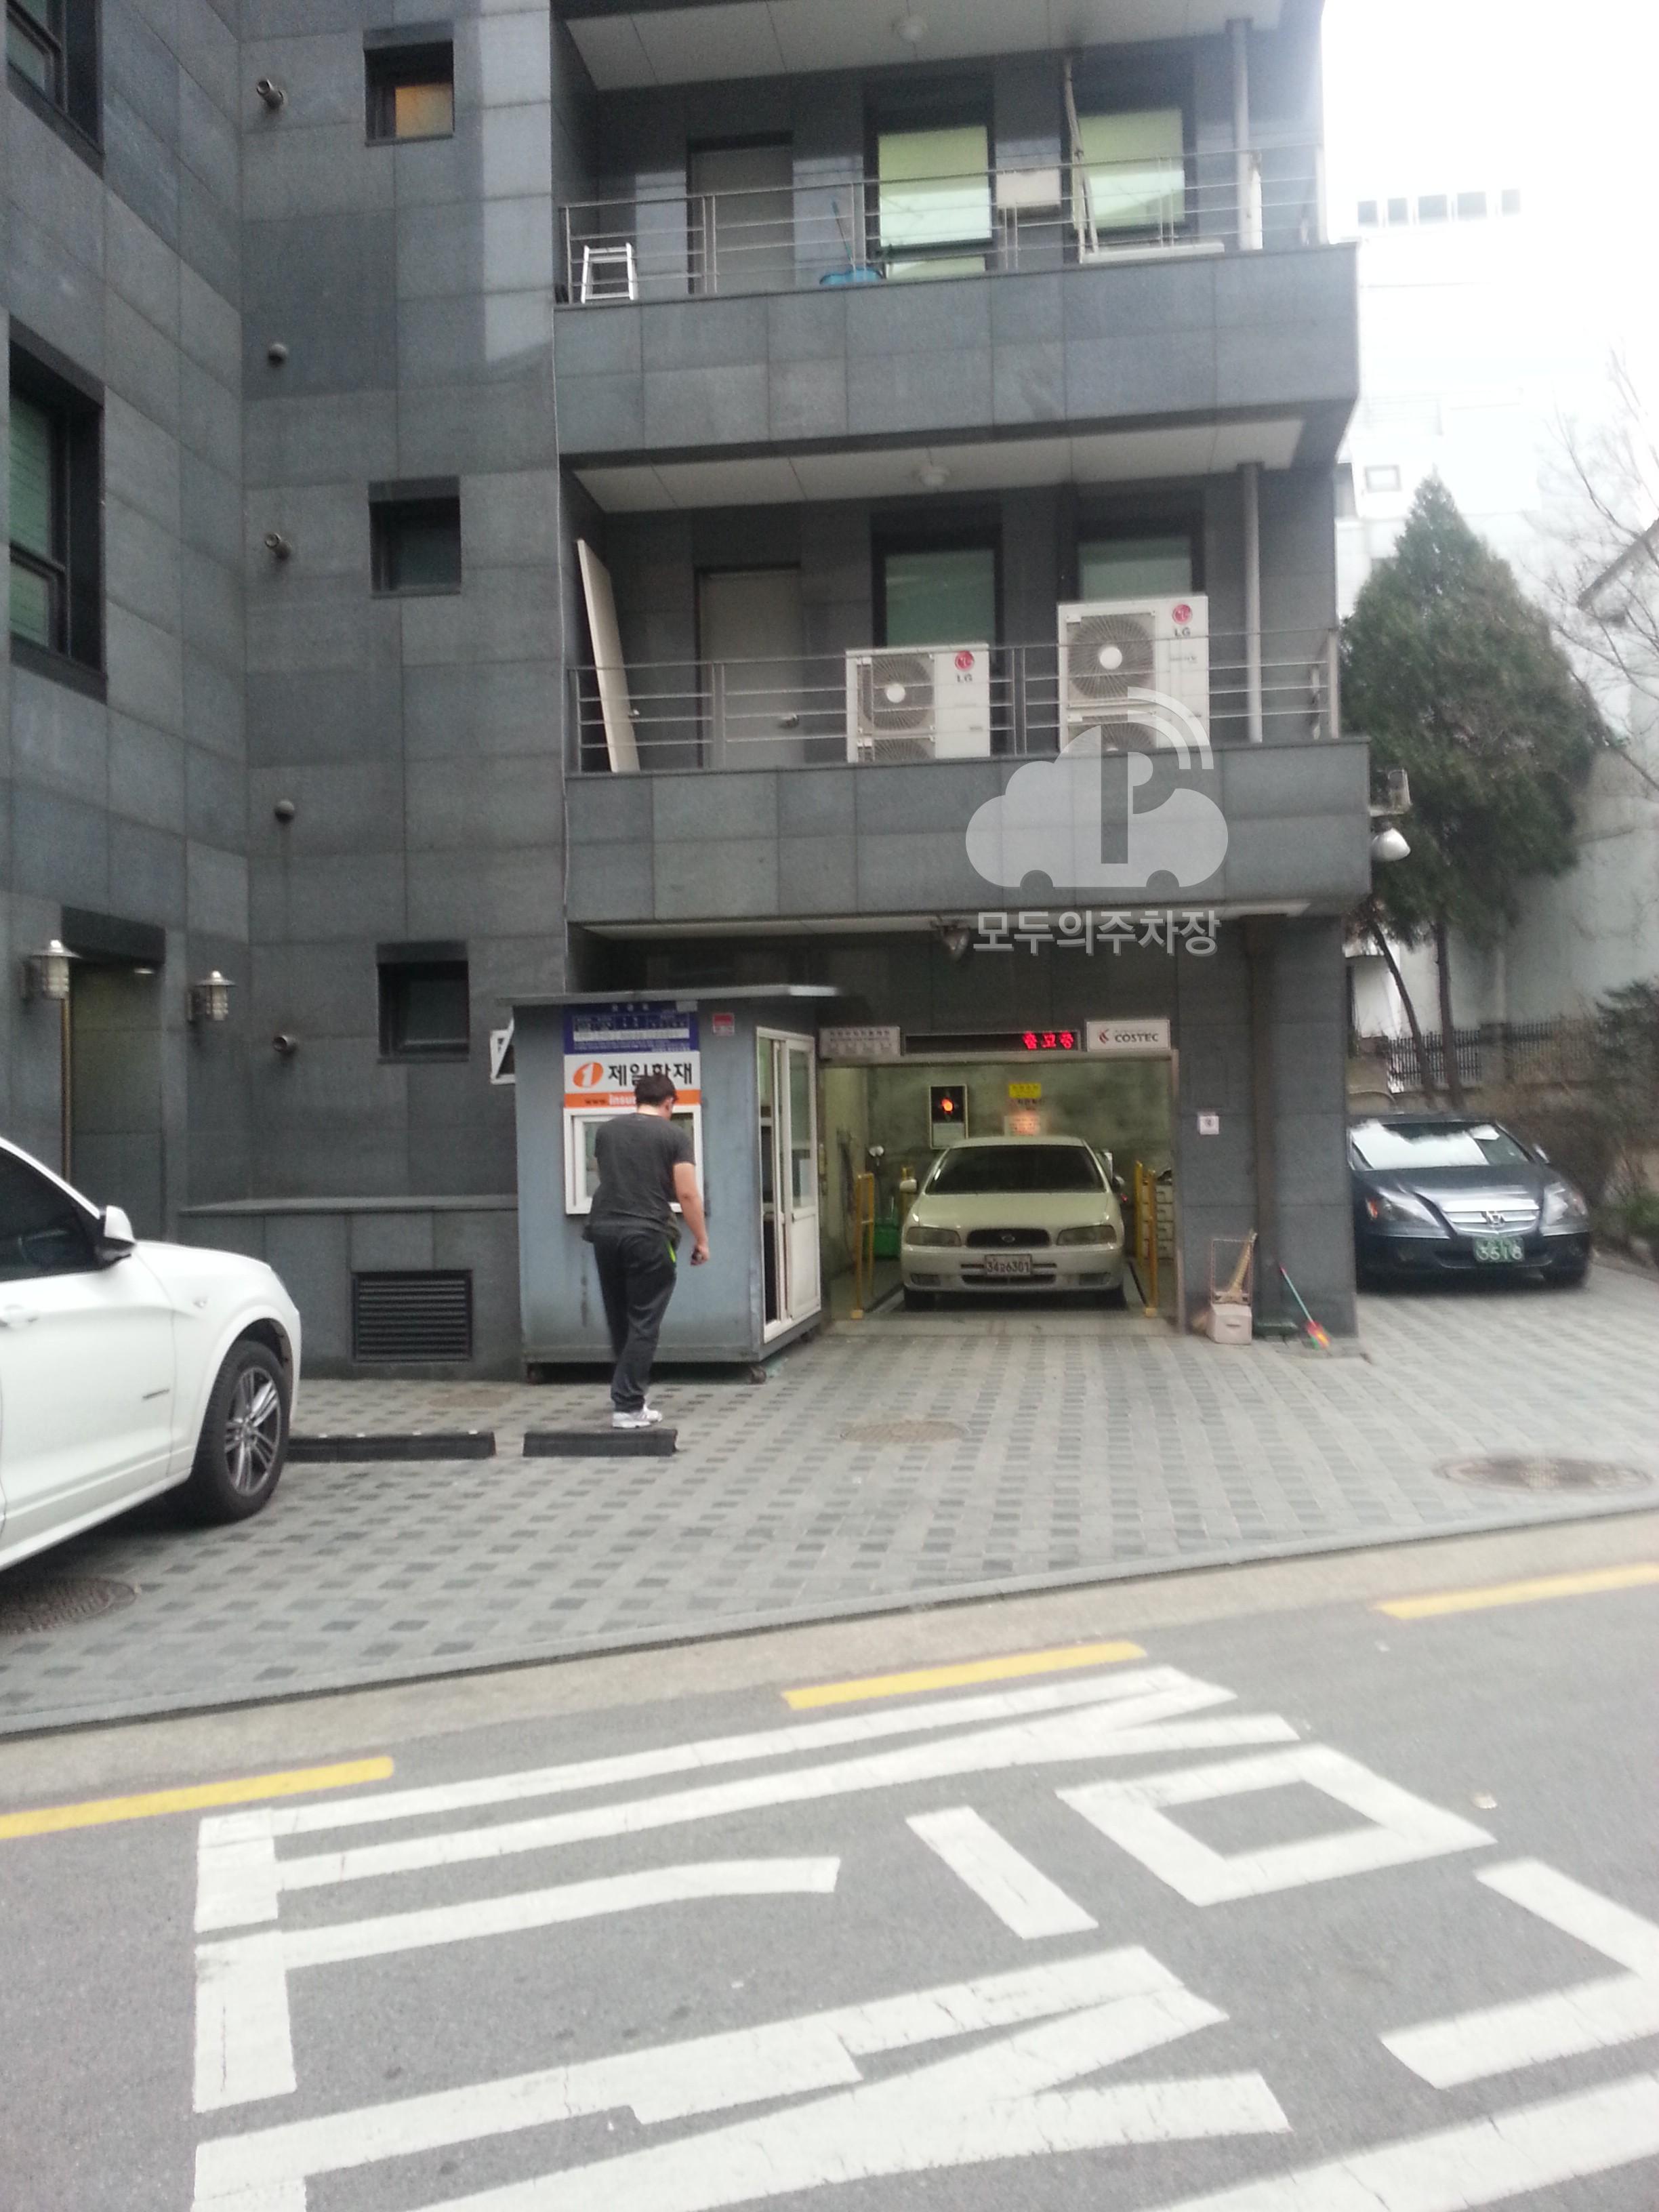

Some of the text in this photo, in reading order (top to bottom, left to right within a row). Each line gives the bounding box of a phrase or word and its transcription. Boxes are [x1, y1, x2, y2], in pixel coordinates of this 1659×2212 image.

[1174, 628, 1191, 638] LG
[956, 674, 973, 683] LG
[1114, 1033, 1159, 1043] COSTEC
